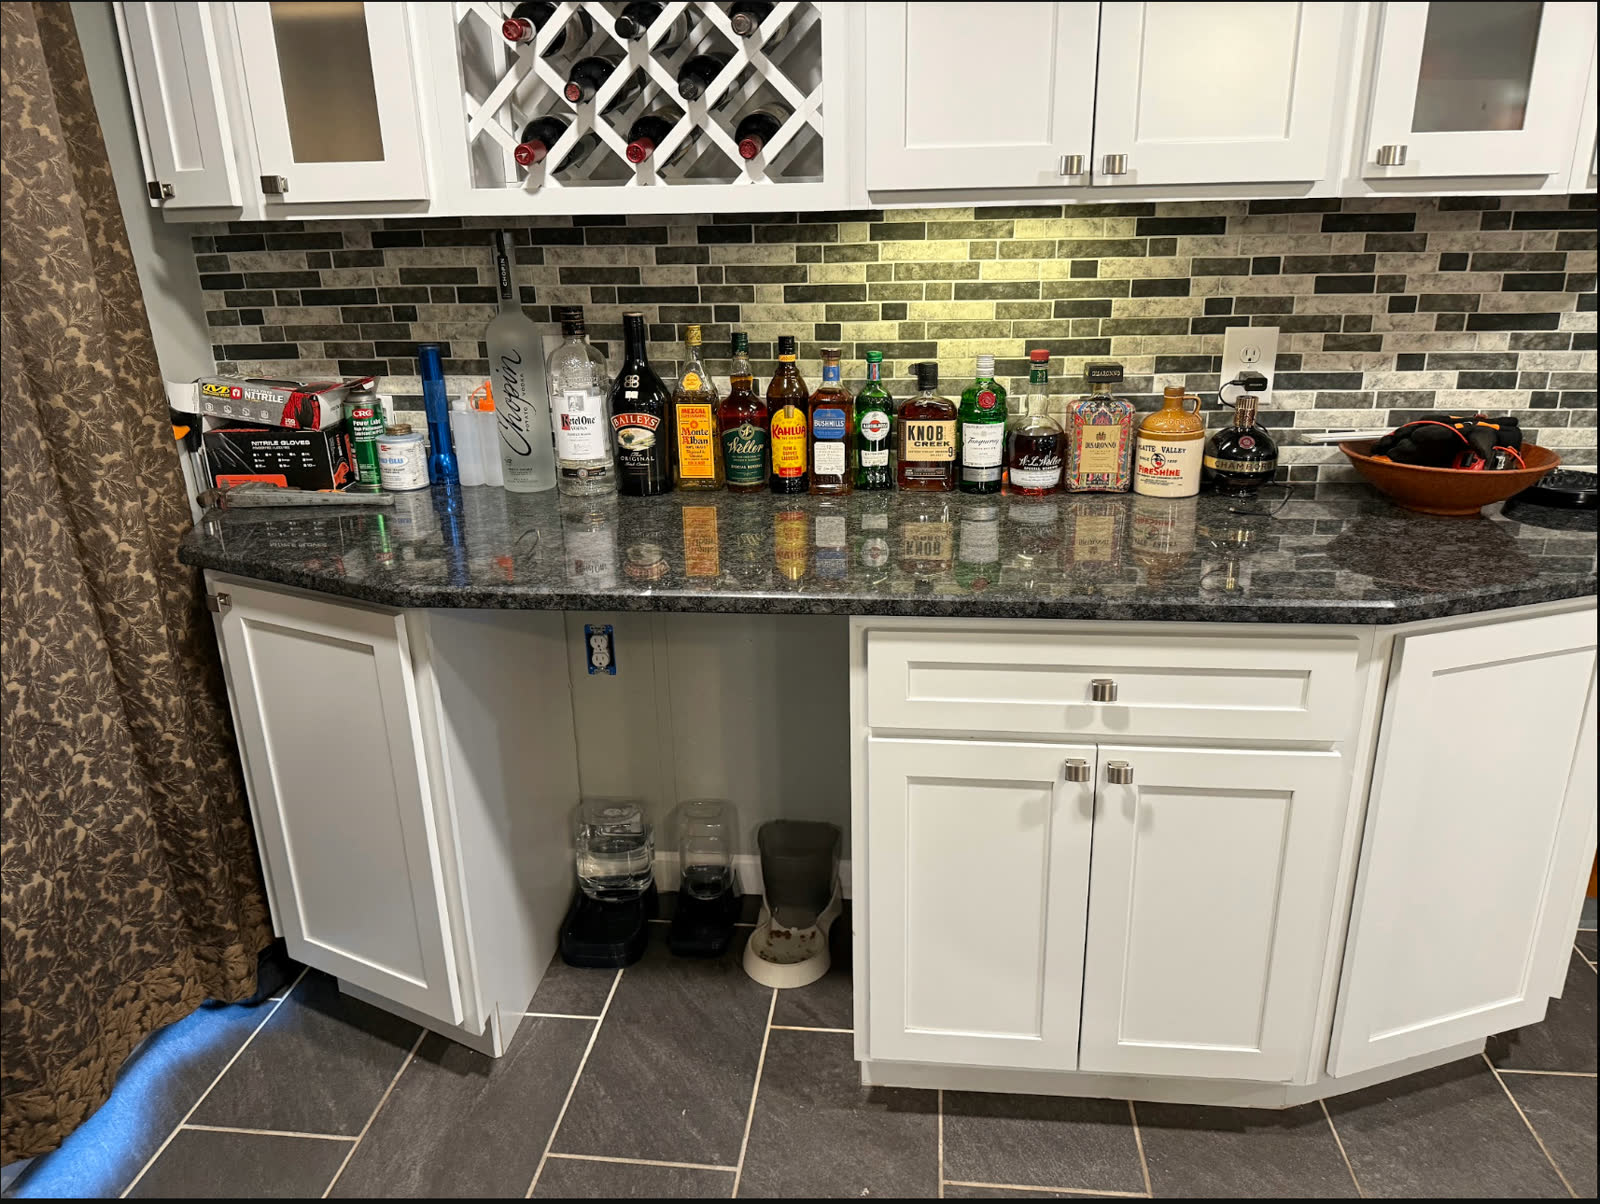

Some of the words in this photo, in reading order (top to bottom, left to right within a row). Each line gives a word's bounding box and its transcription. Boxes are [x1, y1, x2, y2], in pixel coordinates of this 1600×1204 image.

[500, 257, 508, 287] CHOPIN
[244, 390, 285, 404] NITRILE
[496, 349, 536, 457] Chopin
[352, 409, 373, 418] CRC
[523, 407, 531, 432] POTATO
[561, 415, 581, 428] Ketel
[581, 416, 596, 425] One
[613, 415, 659, 427] BAILEYS
[680, 427, 709, 436] Monte
[771, 423, 806, 439] KAHLÚA
[907, 425, 944, 441] KNOB
[682, 436, 709, 445] Alban
[727, 436, 764, 454] Weller
[948, 446, 954, 458] 9
[1161, 446, 1187, 454] VALLEY
